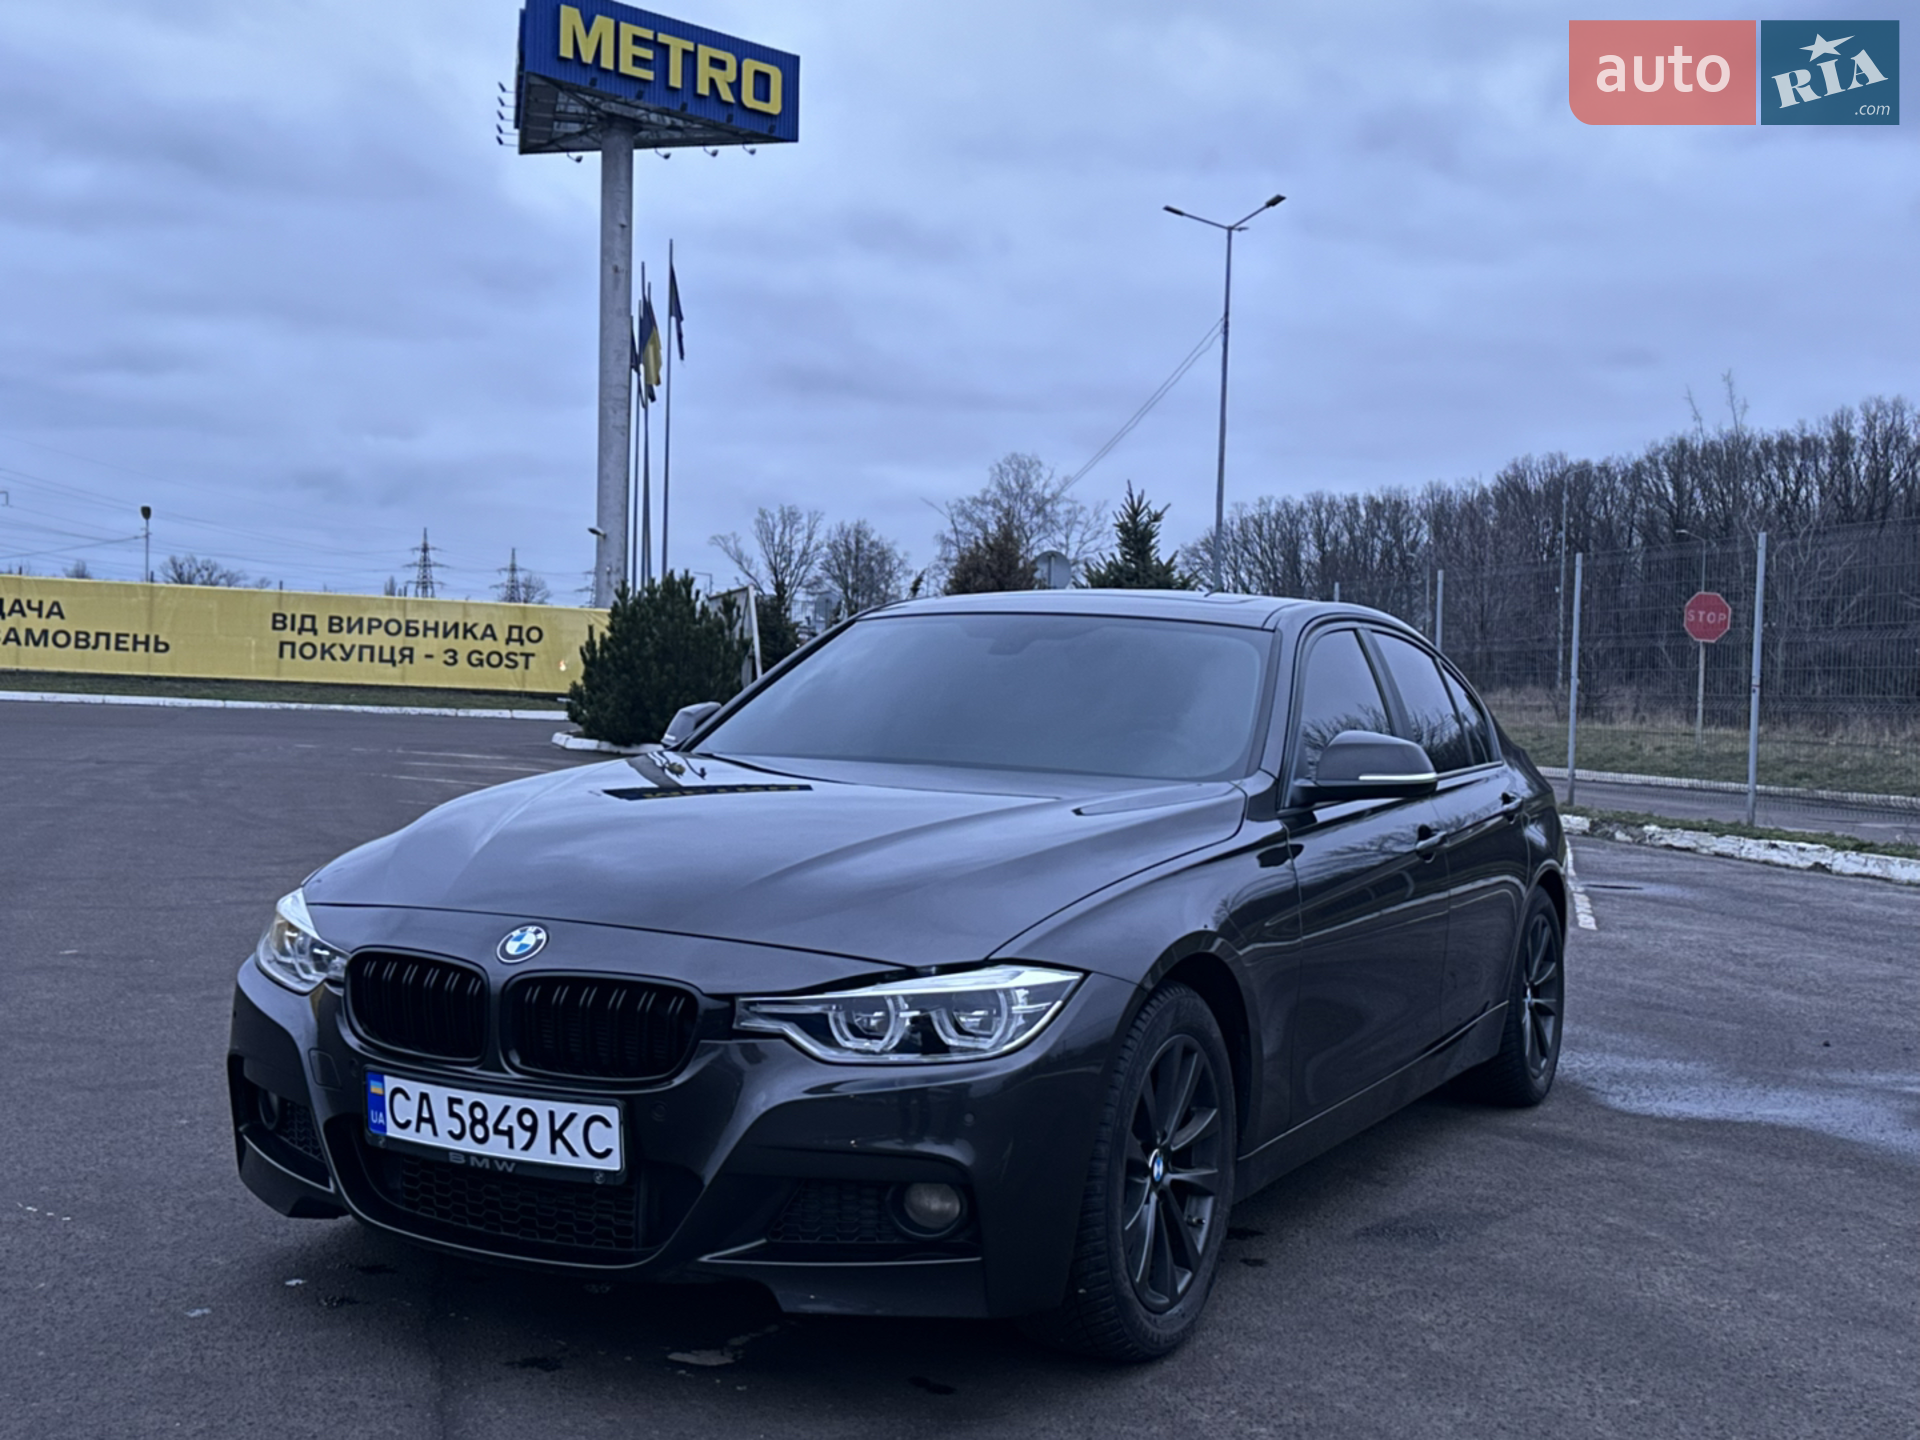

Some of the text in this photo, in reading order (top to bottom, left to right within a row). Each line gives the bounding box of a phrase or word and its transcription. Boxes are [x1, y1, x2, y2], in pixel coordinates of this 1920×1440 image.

[559, 4, 782, 115] METRO
[0, 597, 66, 621] АЧА
[1687, 609, 1727, 625] STOP
[0, 626, 171, 654] АМОВЛЕНЬ
[271, 612, 544, 646] ВІД ВИРОБНИКА ДО
[278, 640, 414, 668] ПОКУПЦЯ
[466, 649, 536, 670] GOST
[370, 1109, 386, 1126] UA
[388, 1086, 614, 1160] CA 5849 KC
[448, 1151, 517, 1173] BMW
